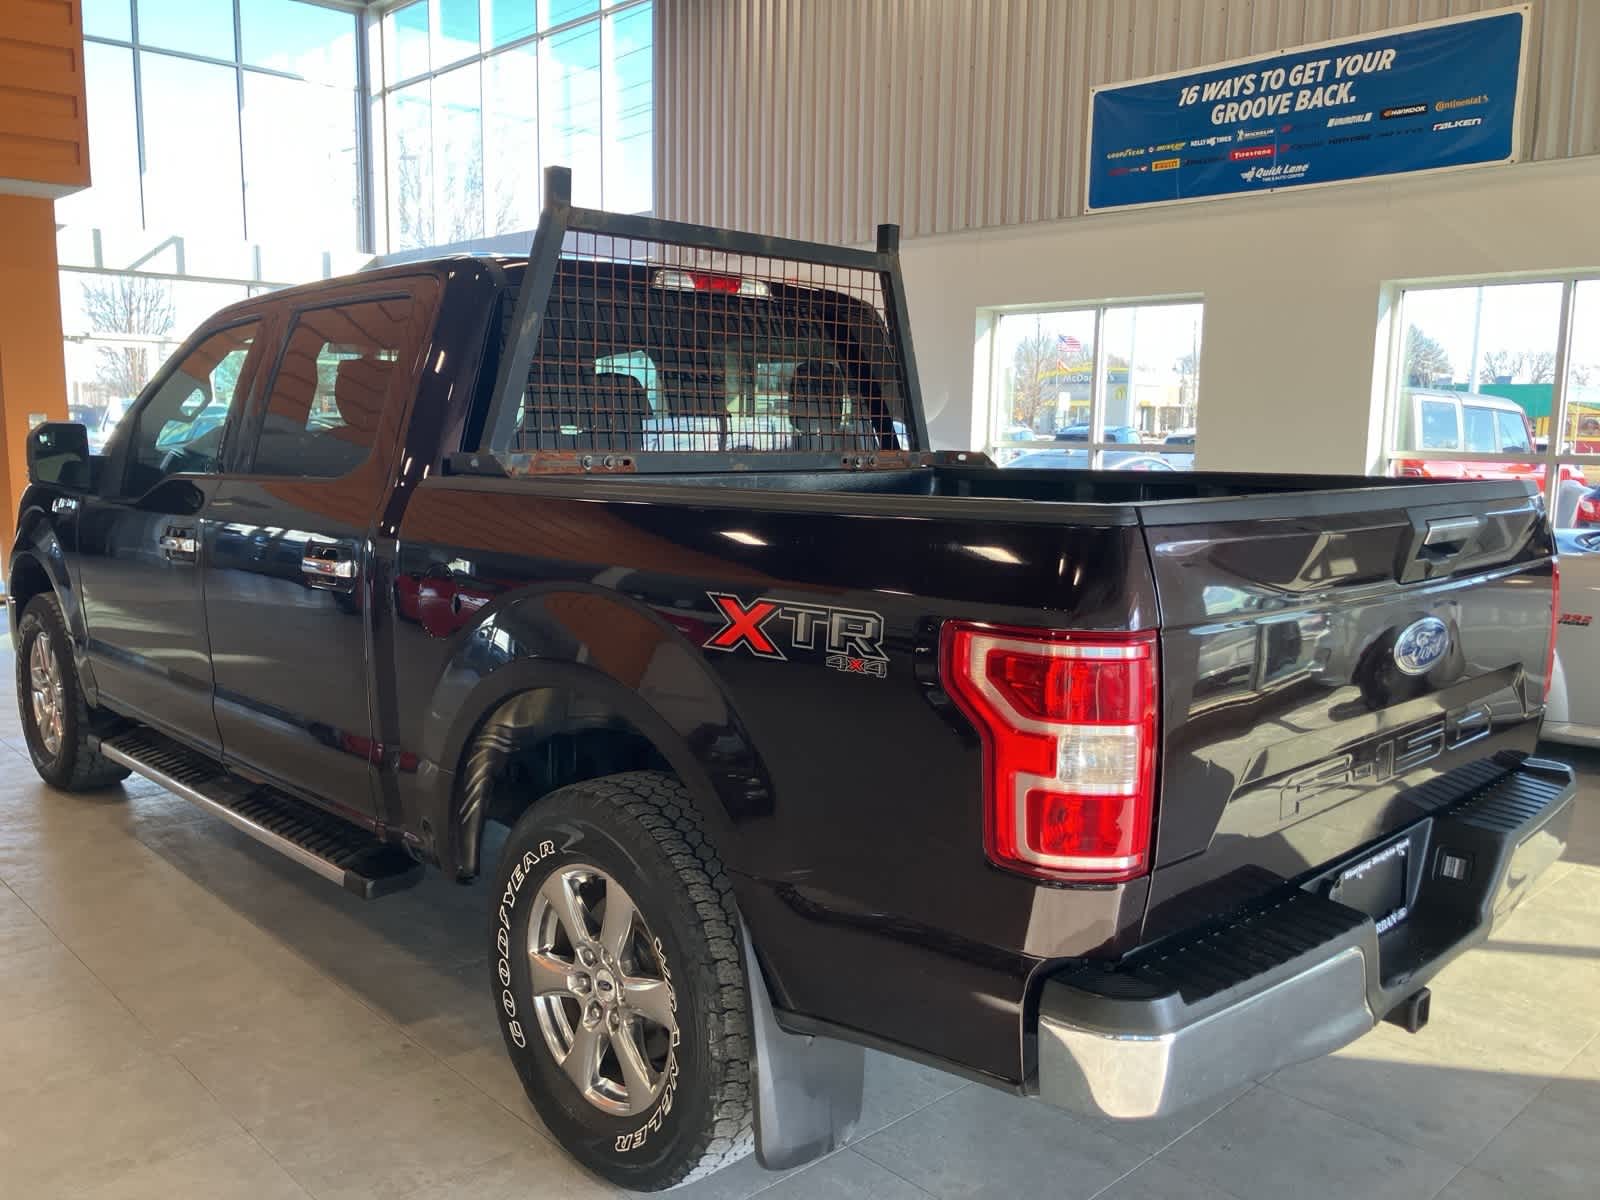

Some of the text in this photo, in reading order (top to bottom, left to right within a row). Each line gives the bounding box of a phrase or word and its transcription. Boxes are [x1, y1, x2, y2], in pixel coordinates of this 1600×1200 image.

[1178, 48, 1396, 107] 16 WAYS TO GET YOUR
[1211, 81, 1356, 126] GROOVE BACK.
[1433, 117, 1482, 131] FALKEN
[1234, 148, 1272, 159] Firestone
[1255, 163, 1309, 179] Quick Lane
[702, 591, 890, 661] XTR
[496, 840, 555, 1048] GOODYEAR
